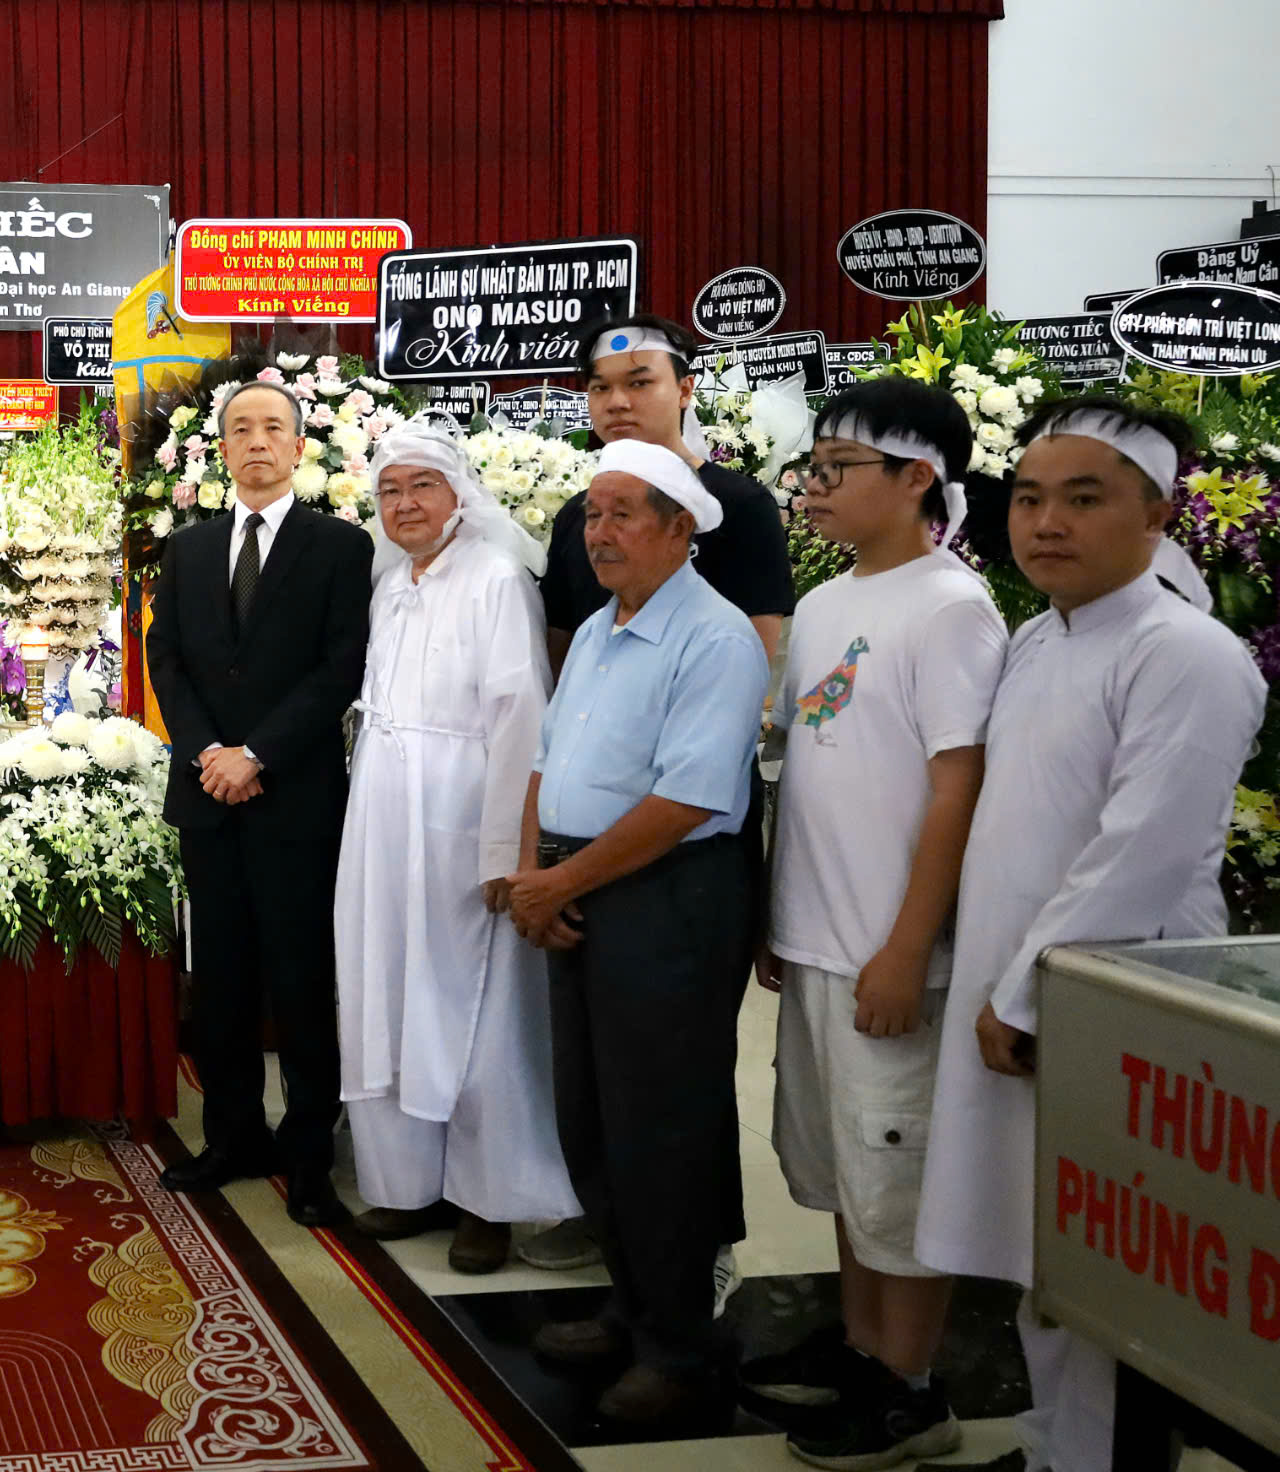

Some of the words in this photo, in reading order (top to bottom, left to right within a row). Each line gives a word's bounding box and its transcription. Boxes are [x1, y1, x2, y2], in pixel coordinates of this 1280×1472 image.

[191, 228, 227, 252] Đồng
[232, 230, 254, 249] chí
[259, 230, 301, 252] PHẠM
[307, 231, 345, 248] MINH
[351, 226, 398, 249] CHÍNH
[223, 253, 241, 269] ỦY
[244, 254, 273, 269] VIÊN
[278, 254, 295, 271] BỘ
[299, 253, 338, 269] CHÍNH
[343, 257, 364, 271] TRỊ
[845, 251, 873, 271] HUYỆN
[873, 249, 896, 268] CHÂU
[918, 246, 937, 265] TỈNH
[939, 249, 951, 264] AN
[952, 248, 979, 263] GIANG
[1197, 248, 1236, 268] Đảng
[1241, 242, 1259, 264] Uỷ
[391, 261, 421, 300] TỔNG
[425, 268, 457, 298] LÃNH
[461, 267, 478, 302] SỰ
[481, 261, 515, 301] NHẬT
[518, 257, 544, 292] BẢN
[548, 263, 568, 297] TẠI
[572, 262, 592, 290] TP.
[596, 259, 628, 288] HCM
[873, 270, 909, 289] Kính
[914, 268, 959, 291] Viếng
[1235, 267, 1256, 285] Nam
[1259, 260, 1278, 282] Cần
[28, 281, 56, 297] học
[61, 282, 82, 295] An
[14, 303, 42, 317] Thơ
[238, 298, 285, 313] Kính
[292, 295, 350, 315] Viếng
[433, 304, 482, 328] ONO
[491, 299, 581, 326] MASUO
[754, 298, 774, 313] NAM
[54, 324, 69, 338] PHÓ
[71, 323, 86, 338] CHỦ
[87, 325, 104, 340] TỊCH
[1073, 317, 1104, 338] TIẾC
[1144, 312, 1175, 334] PHÂN
[1178, 314, 1202, 336] BÓN
[1205, 316, 1224, 338] TRÍ
[1226, 316, 1252, 342] VIỆT
[64, 340, 83, 358] VÕ
[86, 343, 109, 361] THỊ
[405, 328, 509, 369] Kính
[847, 351, 875, 361] CĐCS
[1048, 341, 1078, 357] TÒNG
[1081, 340, 1110, 356] XUÂN
[1152, 341, 1188, 360] THÀNH
[1191, 343, 1216, 361] KÍNH
[1219, 345, 1248, 362] PHÂN
[748, 362, 775, 377] QUÂN
[777, 362, 796, 373] KHU
[797, 361, 803, 371] 9
[1057, 1155, 1228, 1319] PHÚNG
